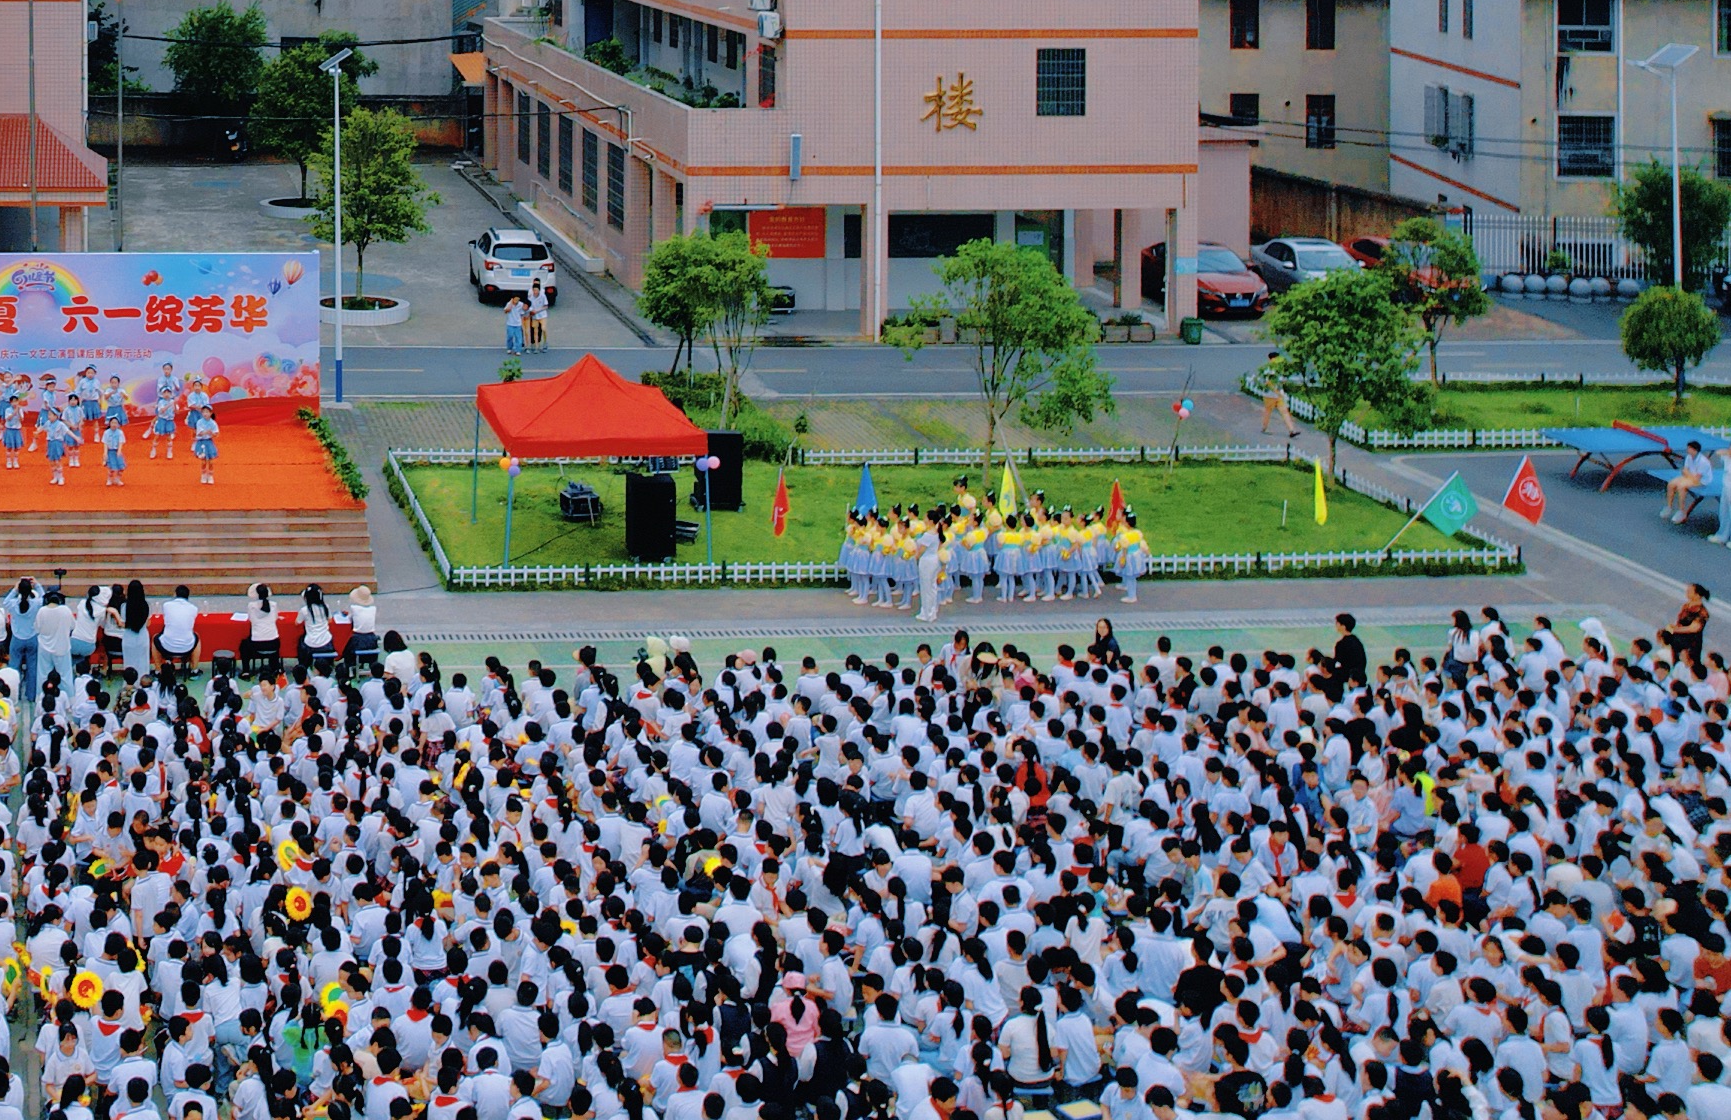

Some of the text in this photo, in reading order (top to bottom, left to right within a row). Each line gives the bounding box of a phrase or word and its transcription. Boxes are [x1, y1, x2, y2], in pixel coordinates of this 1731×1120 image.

[61, 295, 269, 335] 六一绽芳华
